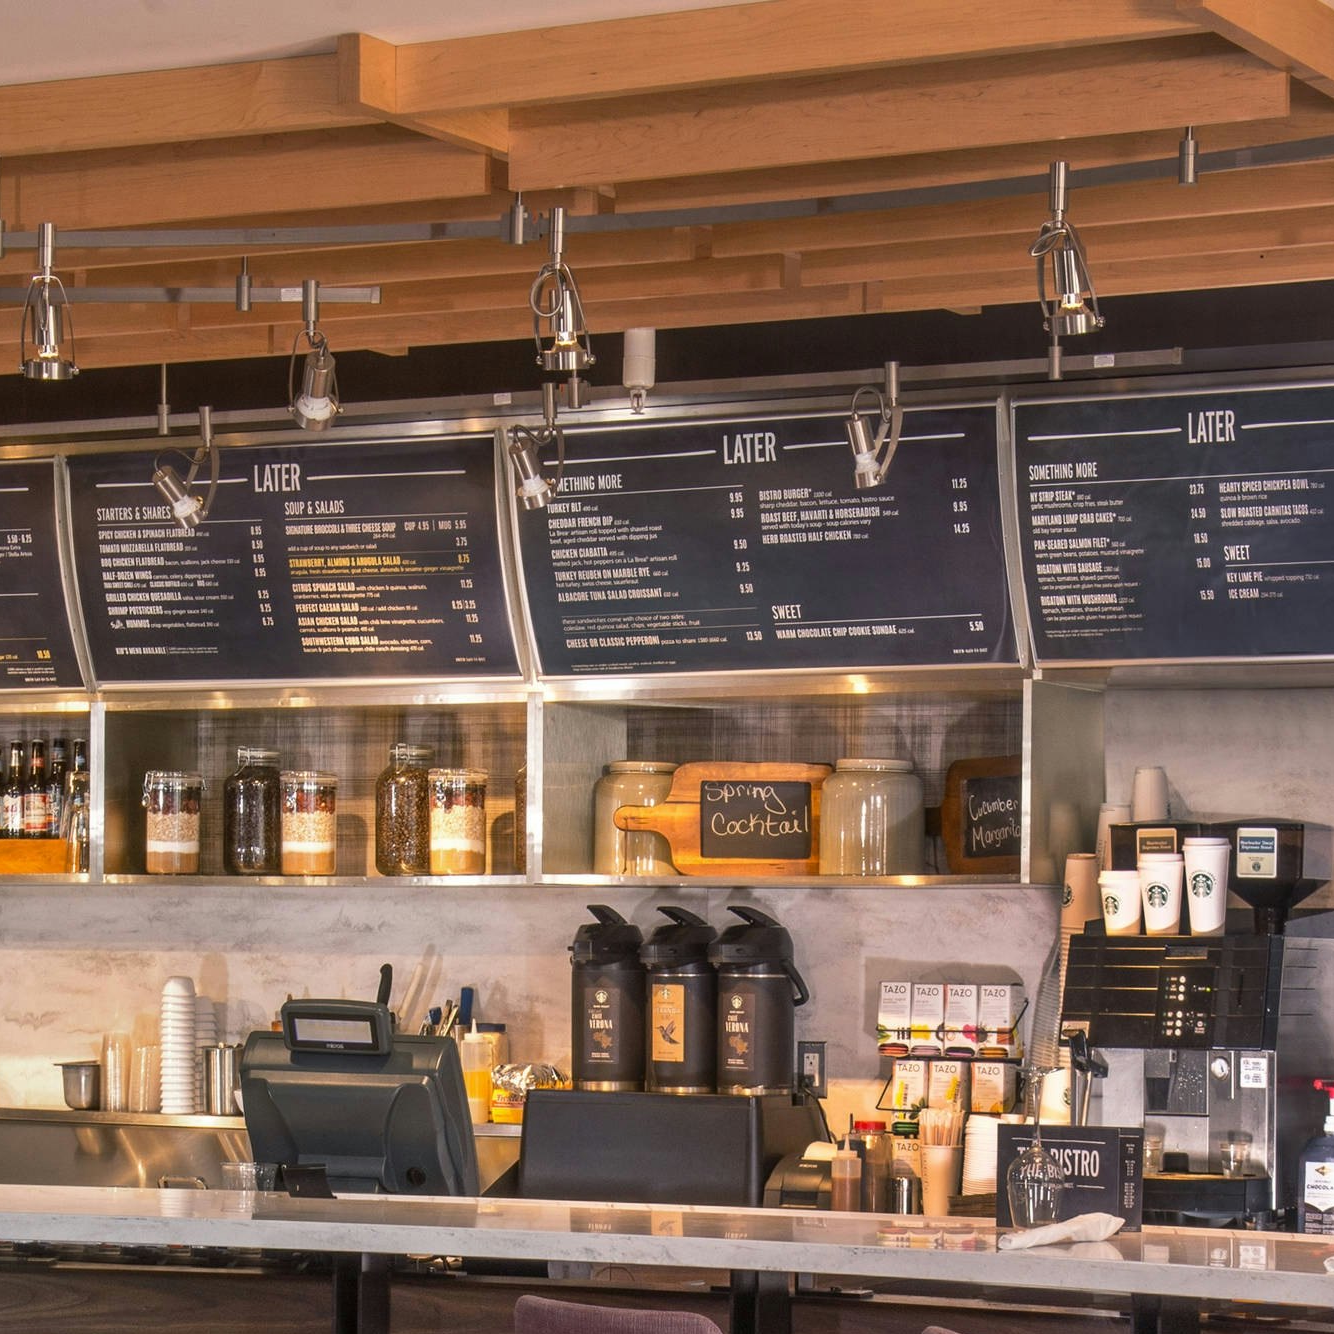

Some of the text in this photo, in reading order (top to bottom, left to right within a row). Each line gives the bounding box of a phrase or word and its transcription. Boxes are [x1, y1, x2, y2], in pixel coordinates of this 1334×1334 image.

[1188, 410, 1235, 444] LATER
[723, 432, 776, 465] LATER
[254, 463, 300, 492] LATER
[1029, 462, 1098, 481] SOMETHING MORE
[598, 474, 623, 489] MORE
[952, 478, 967, 489] 11.25
[1219, 478, 1309, 493] HEARTY SPICED CHICKPEA BOWL
[729, 492, 743, 503] 9.95
[759, 490, 782, 501] BISTRO
[1030, 491, 1055, 502] NY STRIP
[284, 500, 345, 515] SOUP & SALADS
[547, 502, 582, 514] TURKEY BLT
[953, 501, 967, 512] 9.95
[1221, 506, 1263, 519] SLOW ROASTED
[96, 506, 172, 521] STARTERS & SHARES
[761, 506, 880, 523] ROAST HAVARTI HORSERADISH
[404, 521, 415, 531] CUP
[438, 520, 467, 530] MUG 5.95
[548, 516, 613, 529] CHEDDAR FRENCH DIP
[954, 522, 970, 534] 14.25
[98, 530, 114, 540] SPICY
[762, 530, 852, 544] HERB ROASTED HALF CHICKEN
[455, 537, 468, 547] 3.75
[733, 539, 748, 550] 9.50
[551, 547, 608, 560] CHICKEN CIABATTA
[1224, 545, 1250, 561] SWEET
[736, 562, 750, 572] 9.25
[554, 567, 650, 582] TURKEY REUBEN MARBLE RYE
[1226, 571, 1263, 583] KEY LIME PIE
[558, 583, 753, 603] ALBACORE TUNA SALAD CROISSANT 9.50
[1228, 588, 1260, 599] ICE CREAM
[771, 604, 802, 620] SWEET
[776, 621, 984, 639] WARM CHOCOLATE CHIP COOKIE SUNDAE 5.50
[626, 635, 660, 646] PEPPERONI
[704, 781, 787, 814] Spring
[967, 793, 1018, 822] Cucumber
[711, 805, 811, 838] Cocktail
[883, 985, 907, 994] TAZO
[916, 987, 939, 996] TAZO
[949, 988, 972, 997] TAZO
[983, 988, 1007, 998] TAZO
[897, 1063, 920, 1073] TAZO
[934, 1065, 957, 1073] TAZO
[977, 1066, 1000, 1075] TAZO
[896, 1143, 919, 1152] TAZO
